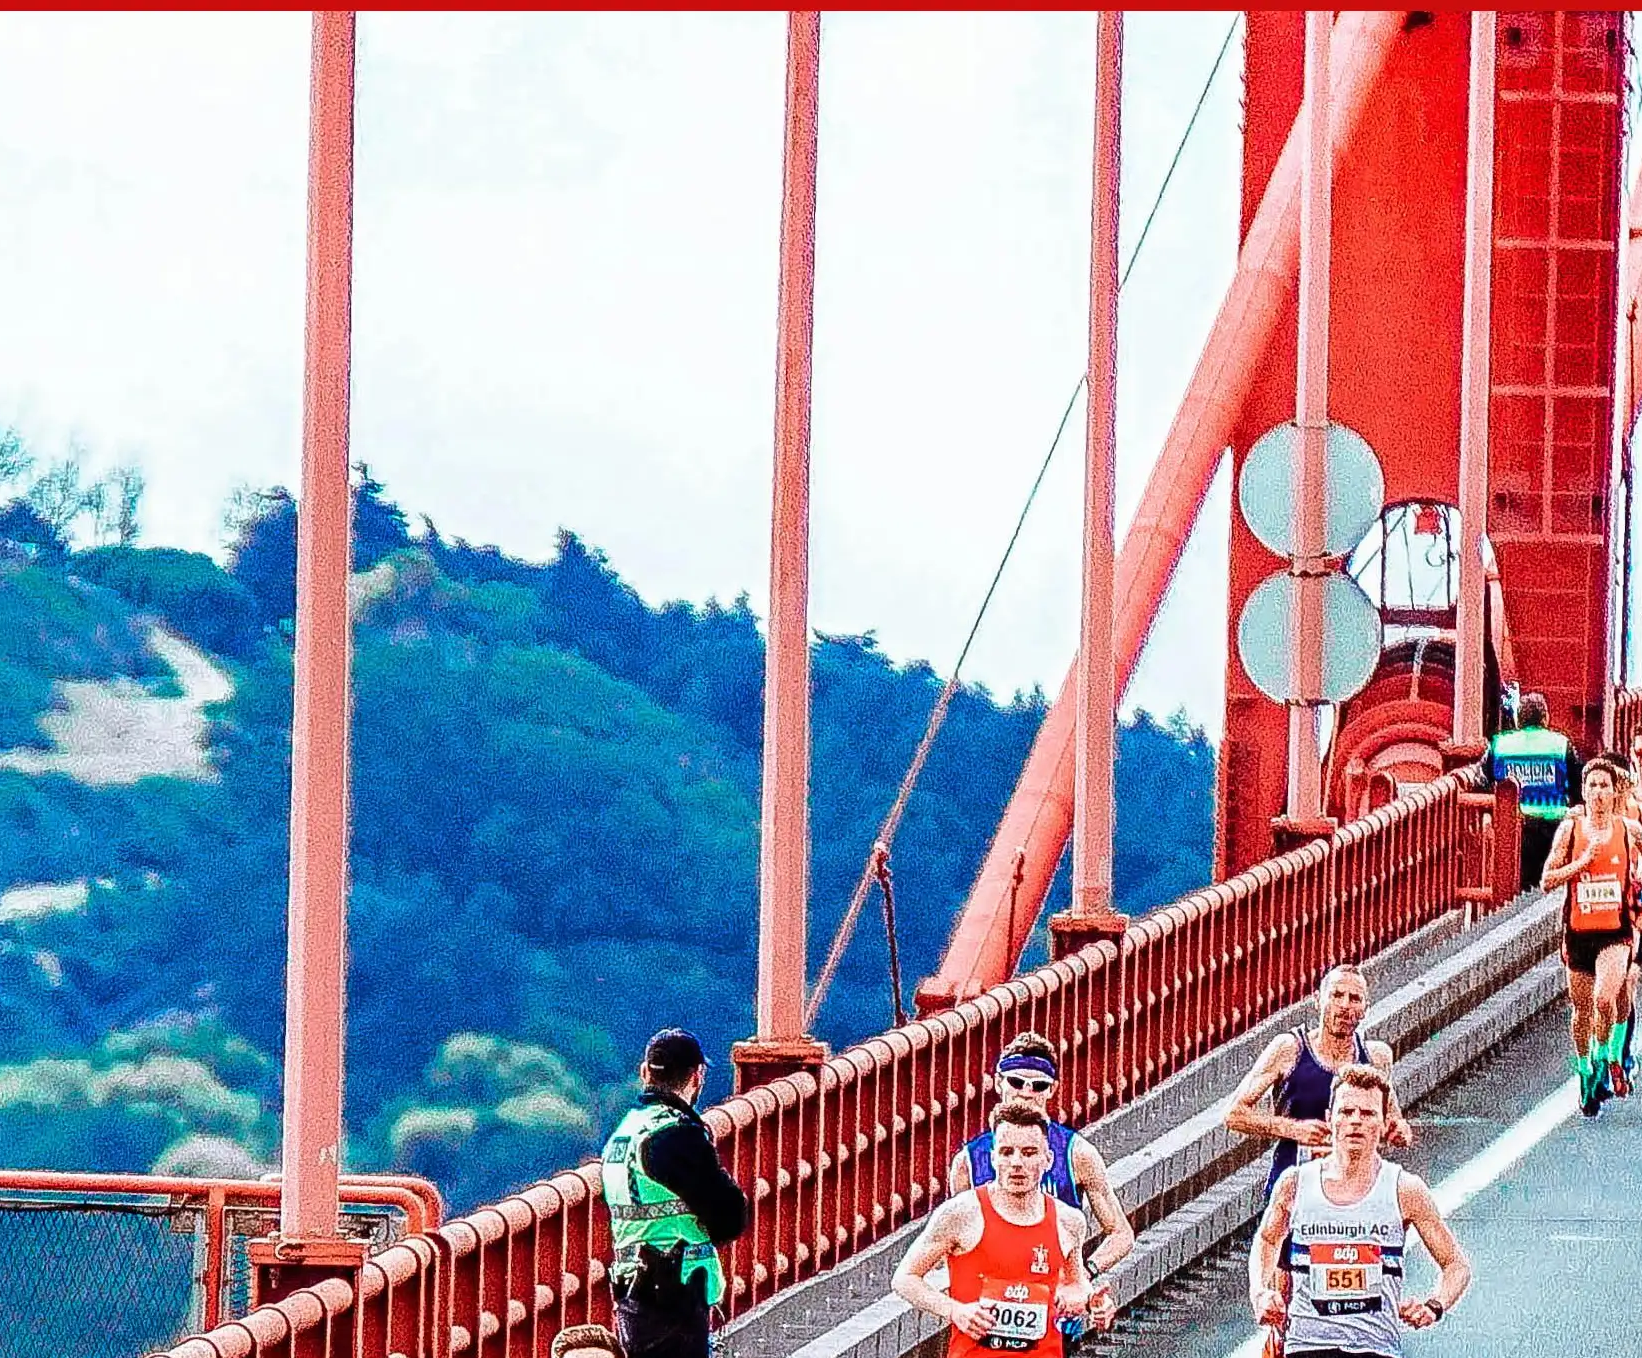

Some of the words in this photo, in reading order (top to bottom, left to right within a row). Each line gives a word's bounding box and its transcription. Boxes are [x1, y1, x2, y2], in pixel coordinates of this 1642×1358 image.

[1301, 1222, 1366, 1237] Edinburgh
[1370, 1224, 1389, 1235] AC
[1328, 1270, 1363, 1288] 551
